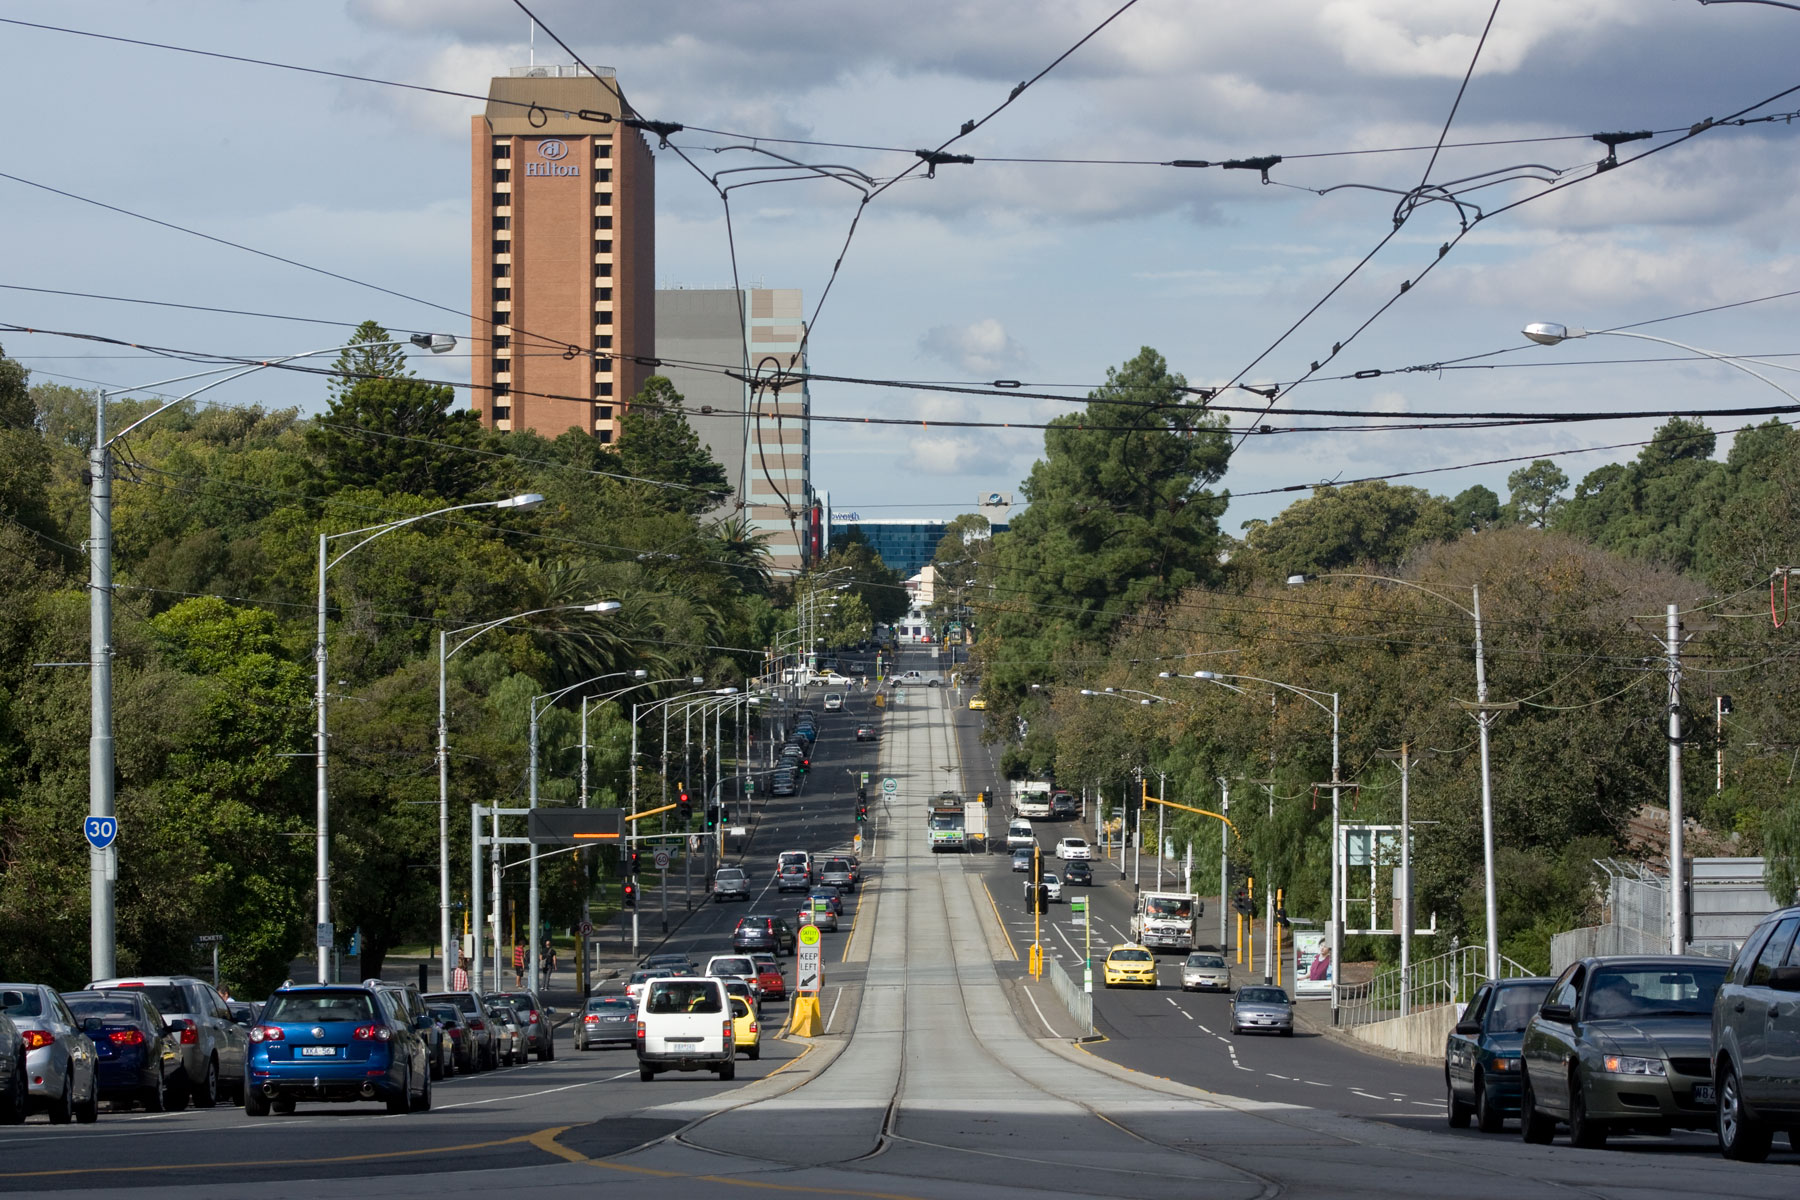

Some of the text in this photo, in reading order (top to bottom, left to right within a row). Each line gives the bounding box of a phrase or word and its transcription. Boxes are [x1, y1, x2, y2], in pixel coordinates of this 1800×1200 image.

[526, 161, 580, 177] Hilton
[89, 821, 112, 837] 30
[657, 855, 667, 863] 60
[199, 934, 223, 942] TICKETS
[800, 952, 818, 961] KEEP
[800, 963, 817, 971] LEFT
